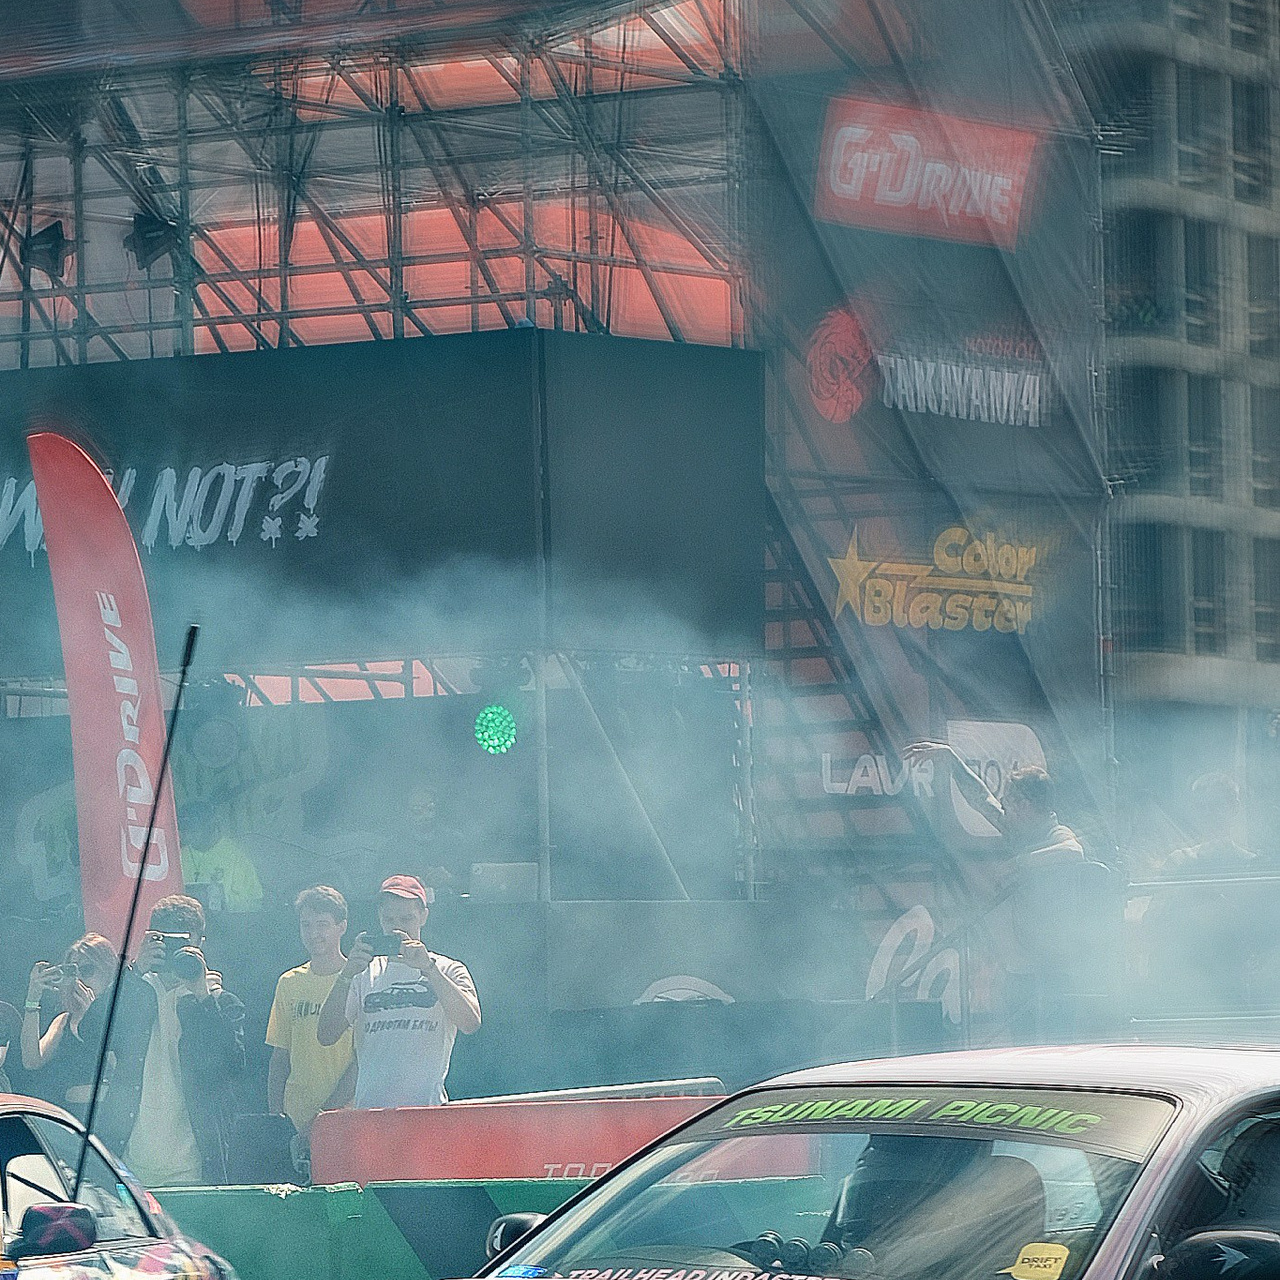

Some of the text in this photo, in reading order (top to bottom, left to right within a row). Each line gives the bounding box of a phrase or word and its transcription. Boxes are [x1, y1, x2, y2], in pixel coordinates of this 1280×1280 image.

[933, 527, 1036, 581] Color
[864, 578, 1032, 635] Blaster
[723, 1098, 1102, 1135] TSUNAMI PICNIC
[1021, 1256, 1062, 1264] DRIFT
